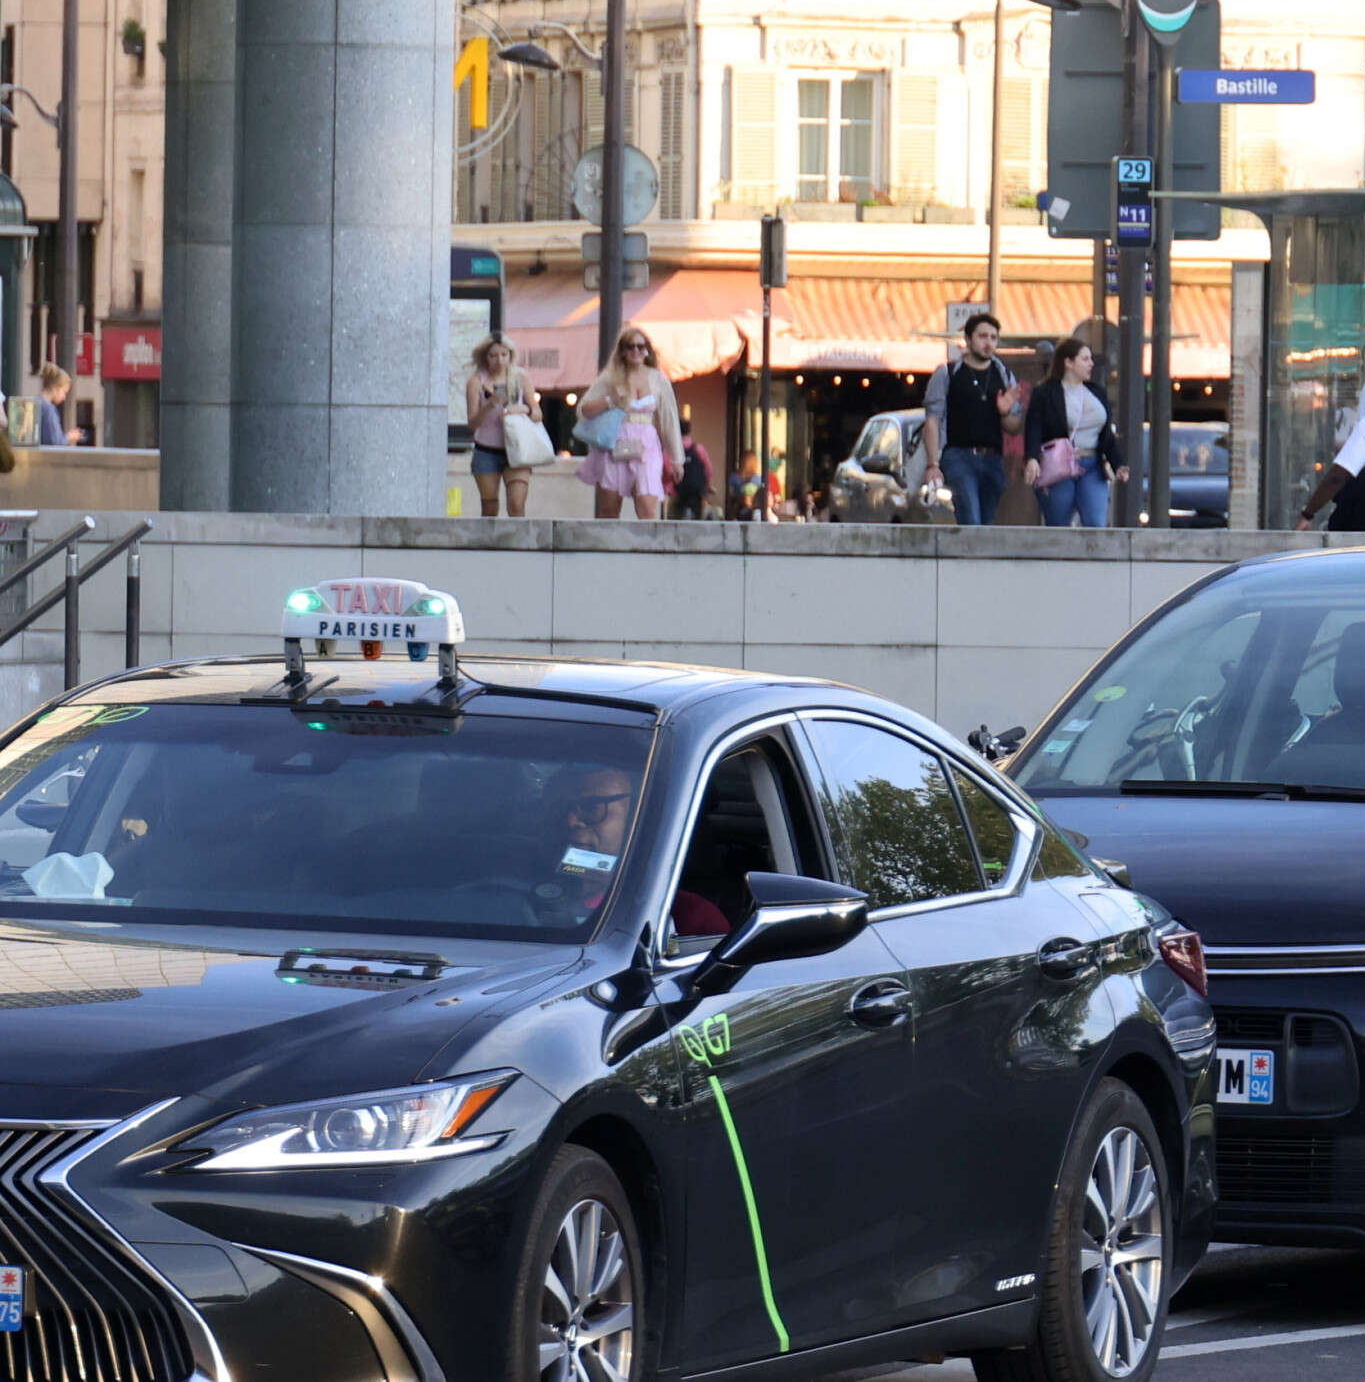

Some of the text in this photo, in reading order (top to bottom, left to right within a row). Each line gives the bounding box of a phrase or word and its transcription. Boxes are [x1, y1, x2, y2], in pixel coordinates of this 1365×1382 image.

[1216, 78, 1278, 96] Bastille
[1123, 162, 1146, 180] 29
[330, 583, 404, 615] TAXI
[319, 621, 417, 638] PARISIEN
[703, 1013, 731, 1056] G7
[1251, 1080, 1268, 1098] 94
